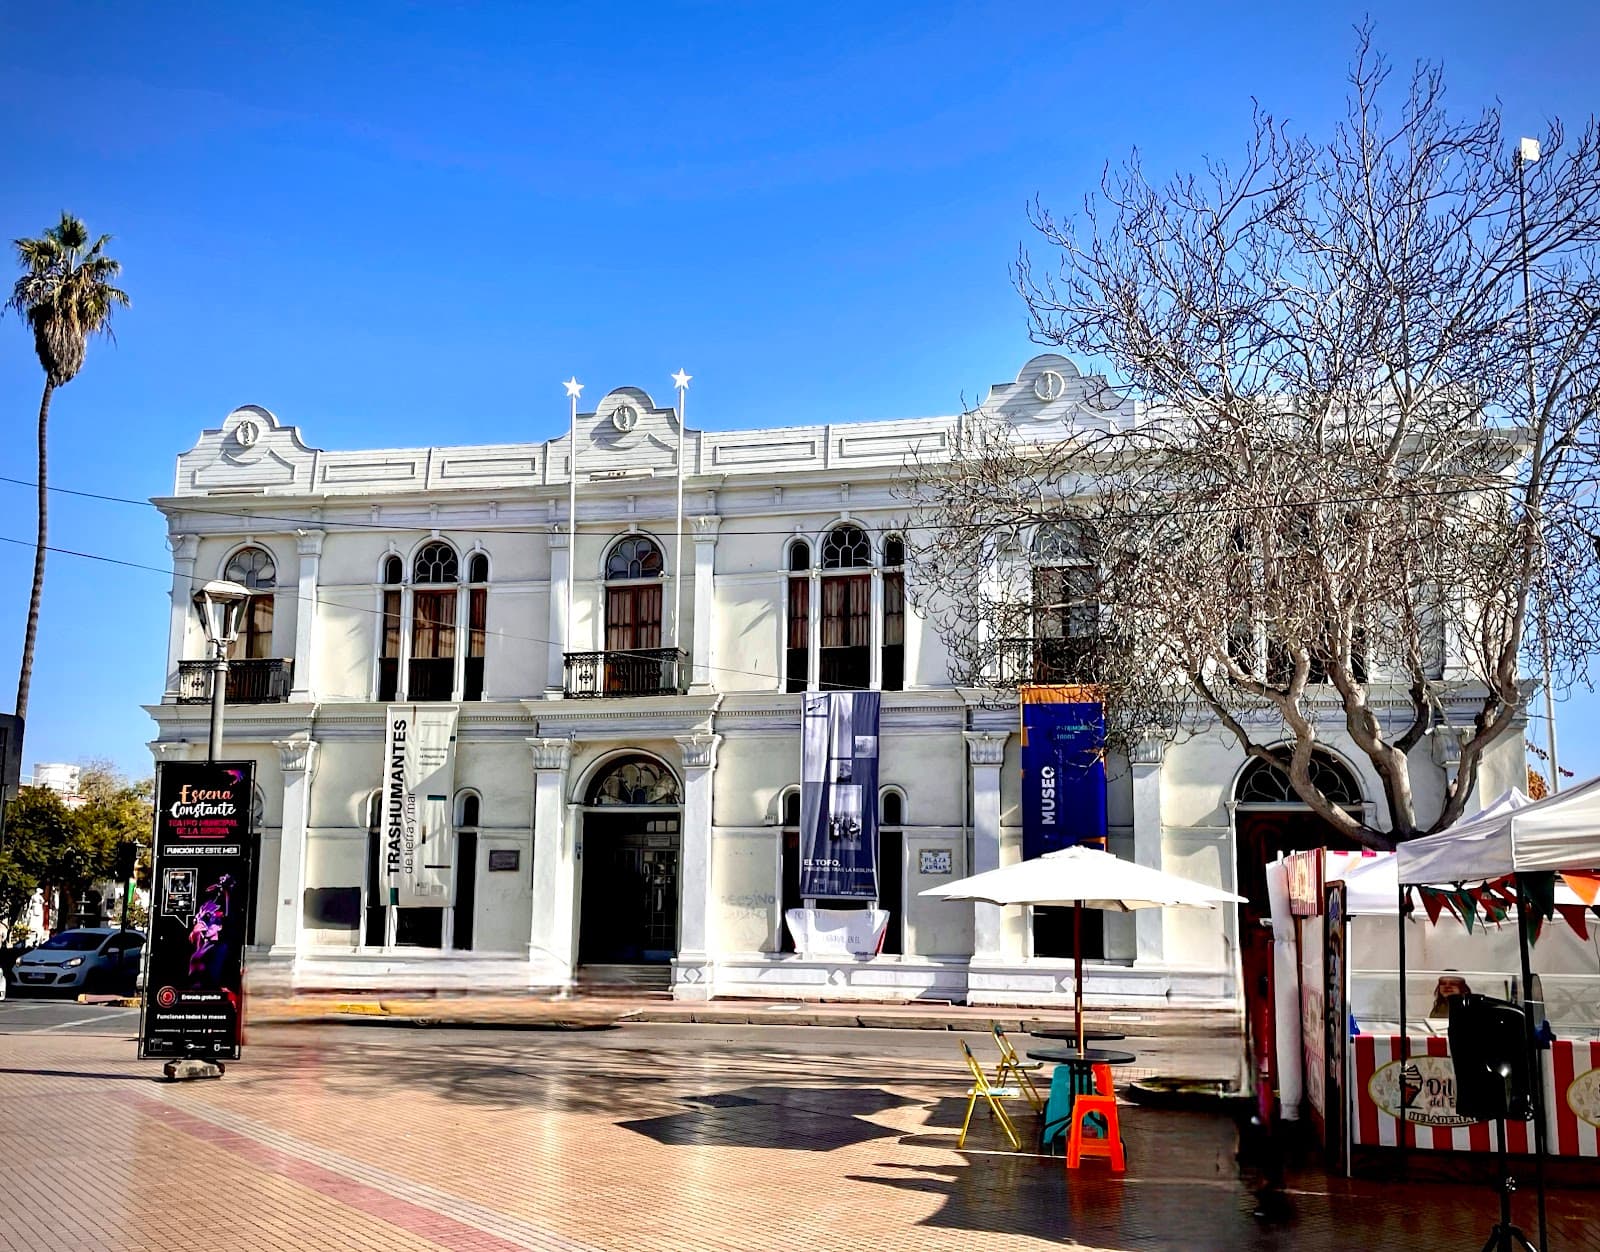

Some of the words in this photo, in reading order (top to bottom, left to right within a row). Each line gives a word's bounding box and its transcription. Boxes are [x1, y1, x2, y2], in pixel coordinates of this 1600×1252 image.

[179, 784, 234, 805] Escena
[388, 719, 407, 876] TRASHUMANTES
[405, 791, 416, 815] mar
[1041, 765, 1056, 825] MUSEO
[169, 801, 237, 818] Constante
[405, 816, 416, 825] y
[403, 826, 414, 856] tierra
[403, 858, 413, 874] de
[815, 859, 841, 867] TOFO,
[1426, 1078, 1456, 1097] Dil
[1430, 1096, 1445, 1108] del
